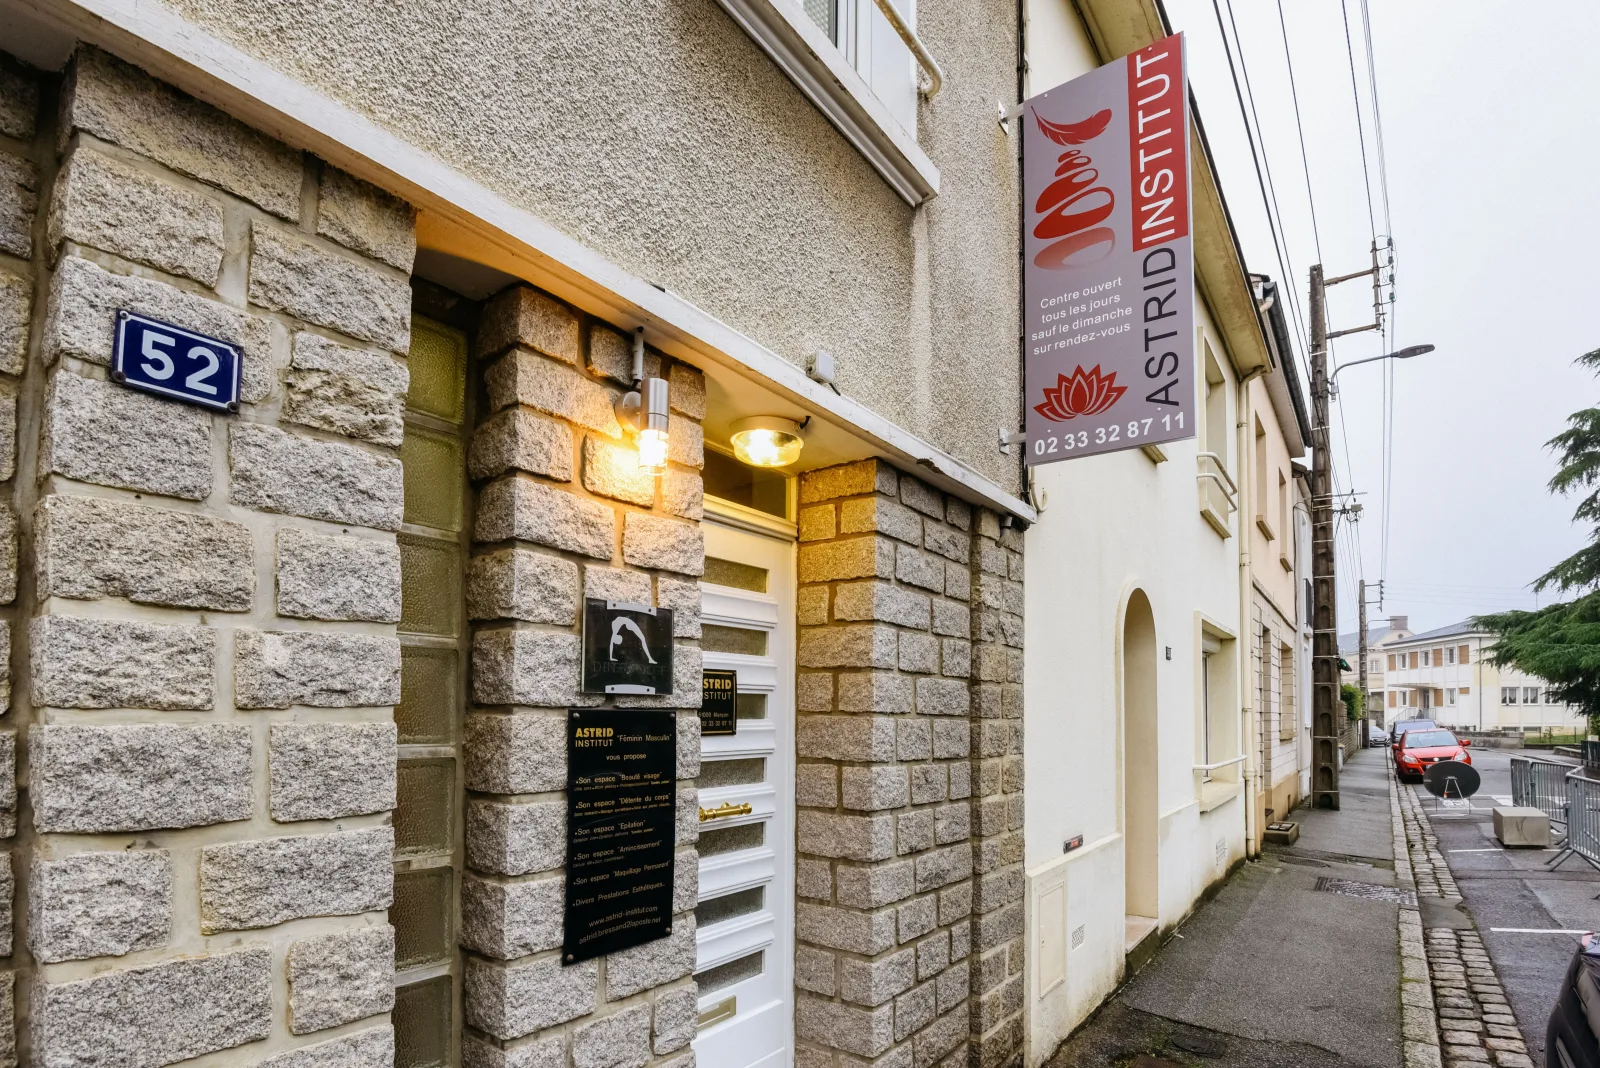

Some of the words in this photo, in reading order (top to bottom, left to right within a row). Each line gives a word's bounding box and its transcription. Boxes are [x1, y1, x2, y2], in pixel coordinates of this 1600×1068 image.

[1136, 52, 1175, 243] INSTITUT
[1040, 289, 1080, 309] Centre
[1082, 277, 1122, 296] ouvert
[1041, 310, 1066, 324] tous
[1069, 302, 1087, 316] les
[1089, 294, 1120, 313] jours
[1031, 325, 1056, 341] sauf
[1059, 323, 1069, 334] le
[1072, 306, 1133, 330] dimanche
[1143, 247, 1179, 407] ASTRID
[1033, 344, 1052, 355] sur
[1054, 323, 1131, 350] rendez-vous
[140, 329, 219, 395] 52
[1034, 436, 1058, 455] 02
[1064, 431, 1088, 450] 33
[1095, 424, 1120, 444] 32
[1127, 418, 1154, 438] 87
[1161, 411, 1184, 432] 11
[703, 678, 732, 690] STRID
[704, 691, 732, 700] STITUT
[576, 728, 614, 738] ASTRID
[575, 739, 614, 748] INSTITUT
[624, 753, 647, 761] propose
[594, 800, 615, 808] espace
[593, 825, 615, 834] espace
[592, 849, 614, 858] espace
[590, 874, 610, 882] espace
[598, 889, 629, 900] Prestations
